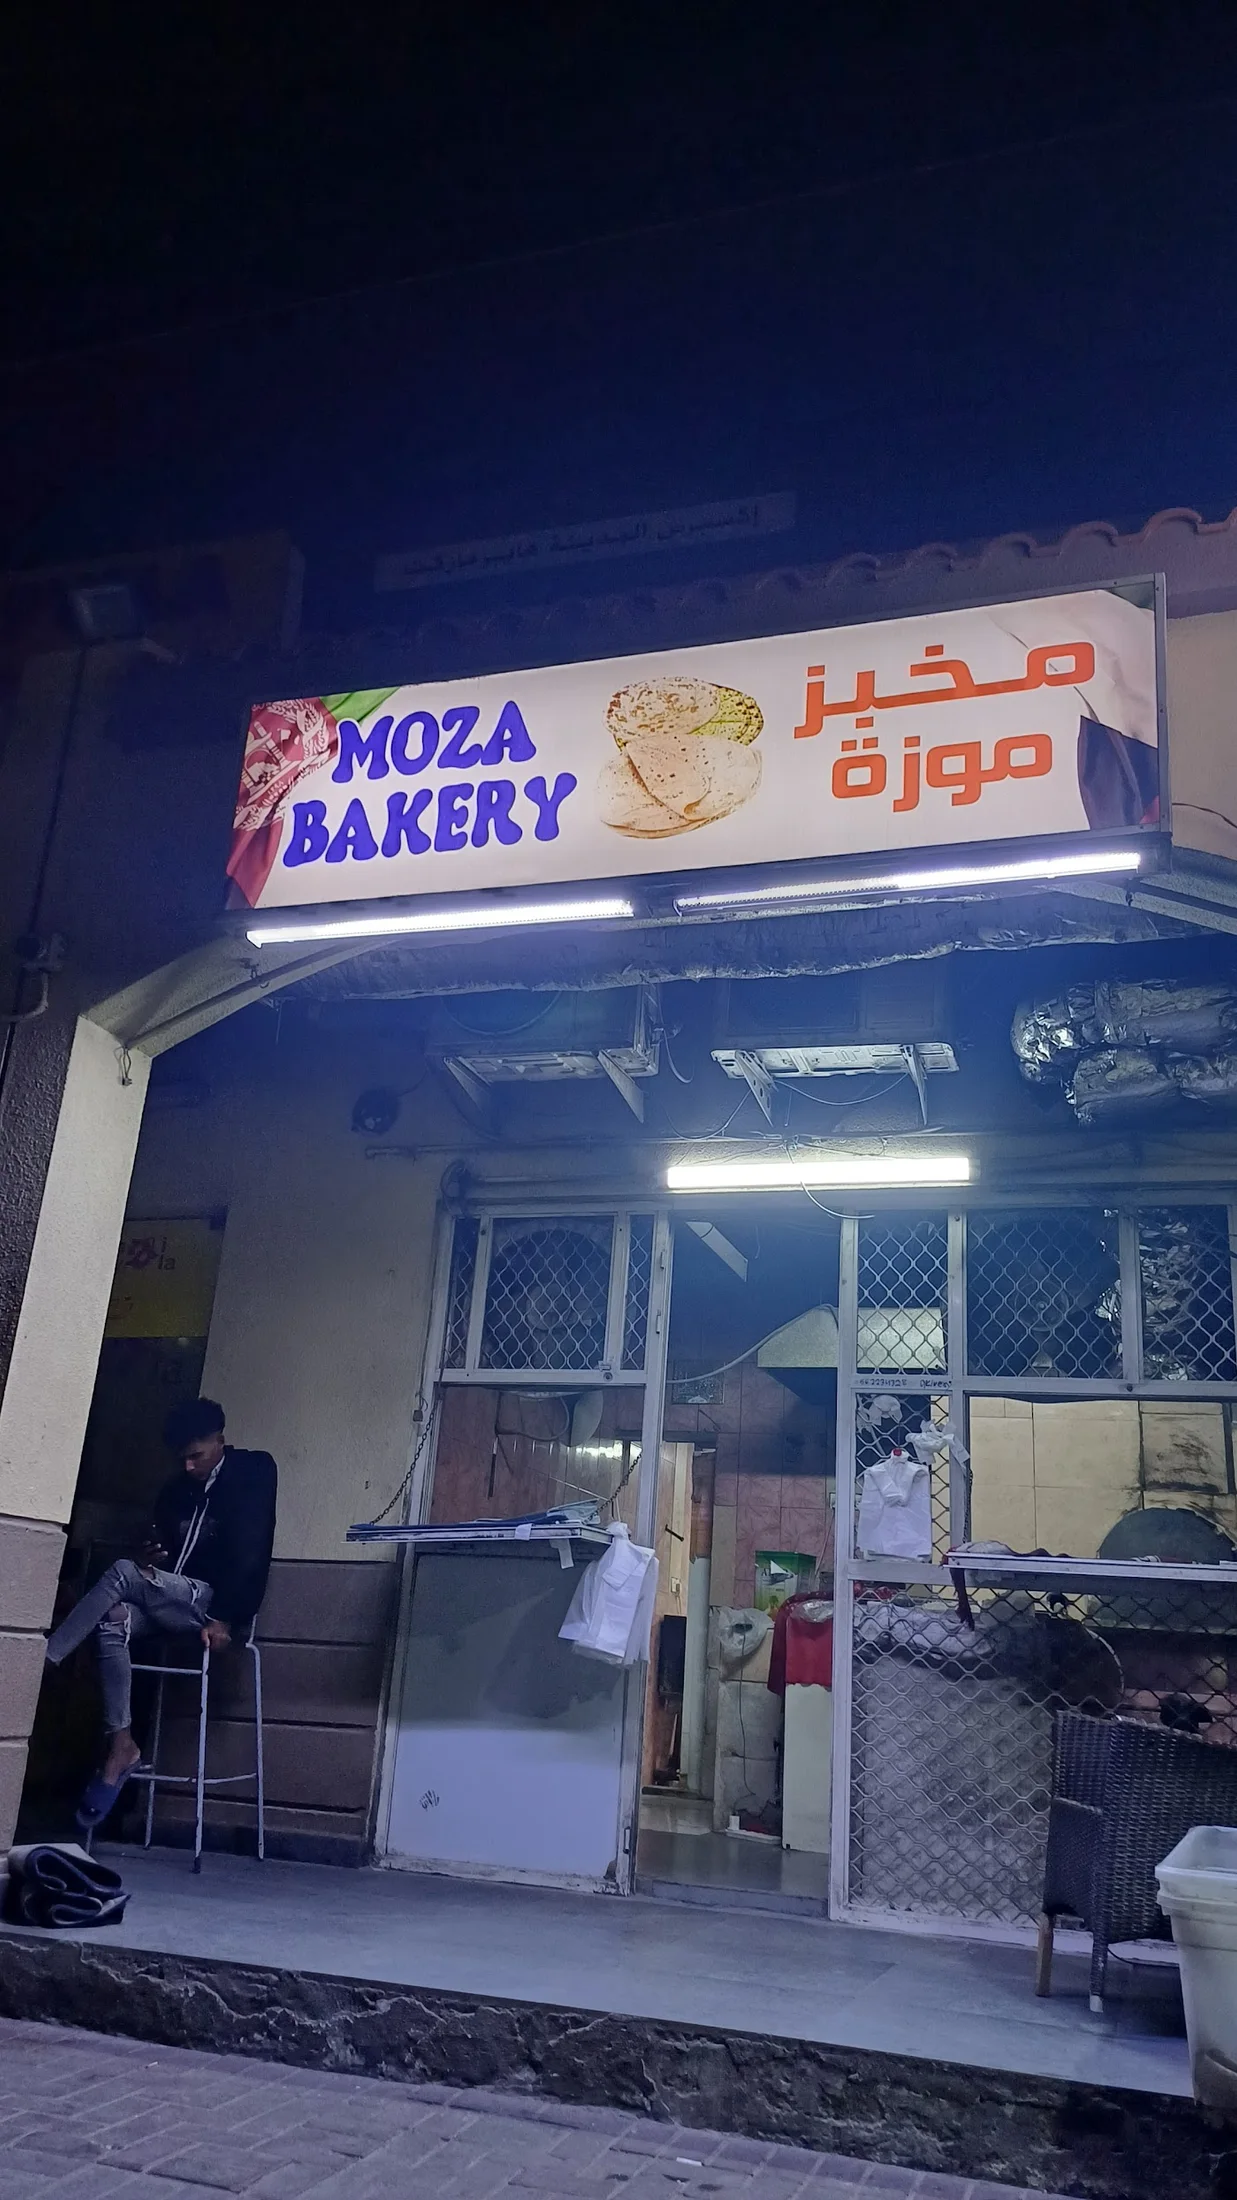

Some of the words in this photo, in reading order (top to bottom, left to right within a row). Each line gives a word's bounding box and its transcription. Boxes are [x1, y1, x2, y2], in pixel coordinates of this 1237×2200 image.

[794, 643, 1093, 738] مخبز
[332, 701, 536, 784] MOZA
[832, 735, 1051, 811] موزة
[285, 773, 576, 868] BAKERY
